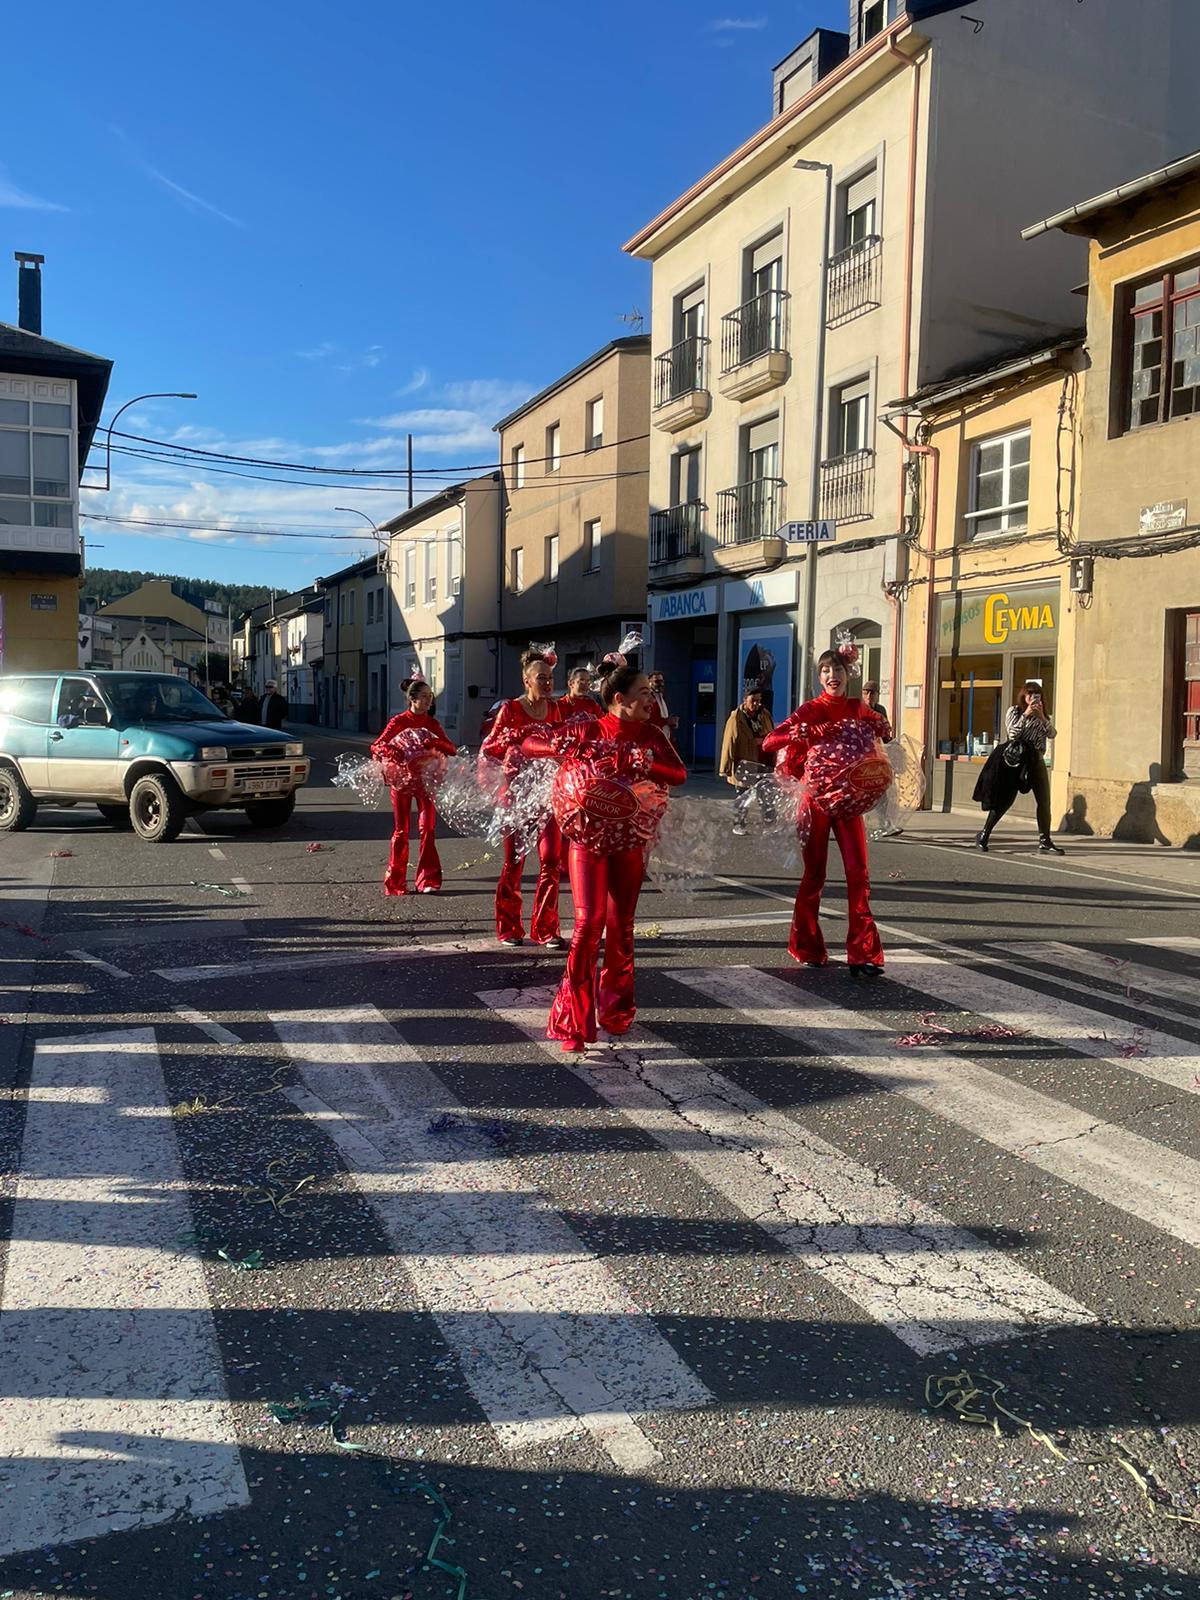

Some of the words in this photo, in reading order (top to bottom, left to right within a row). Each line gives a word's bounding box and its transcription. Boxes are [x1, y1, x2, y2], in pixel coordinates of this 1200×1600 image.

[789, 522, 829, 540] FERIA
[985, 593, 1054, 644] CEYMA
[585, 799, 620, 816] LINDOR
